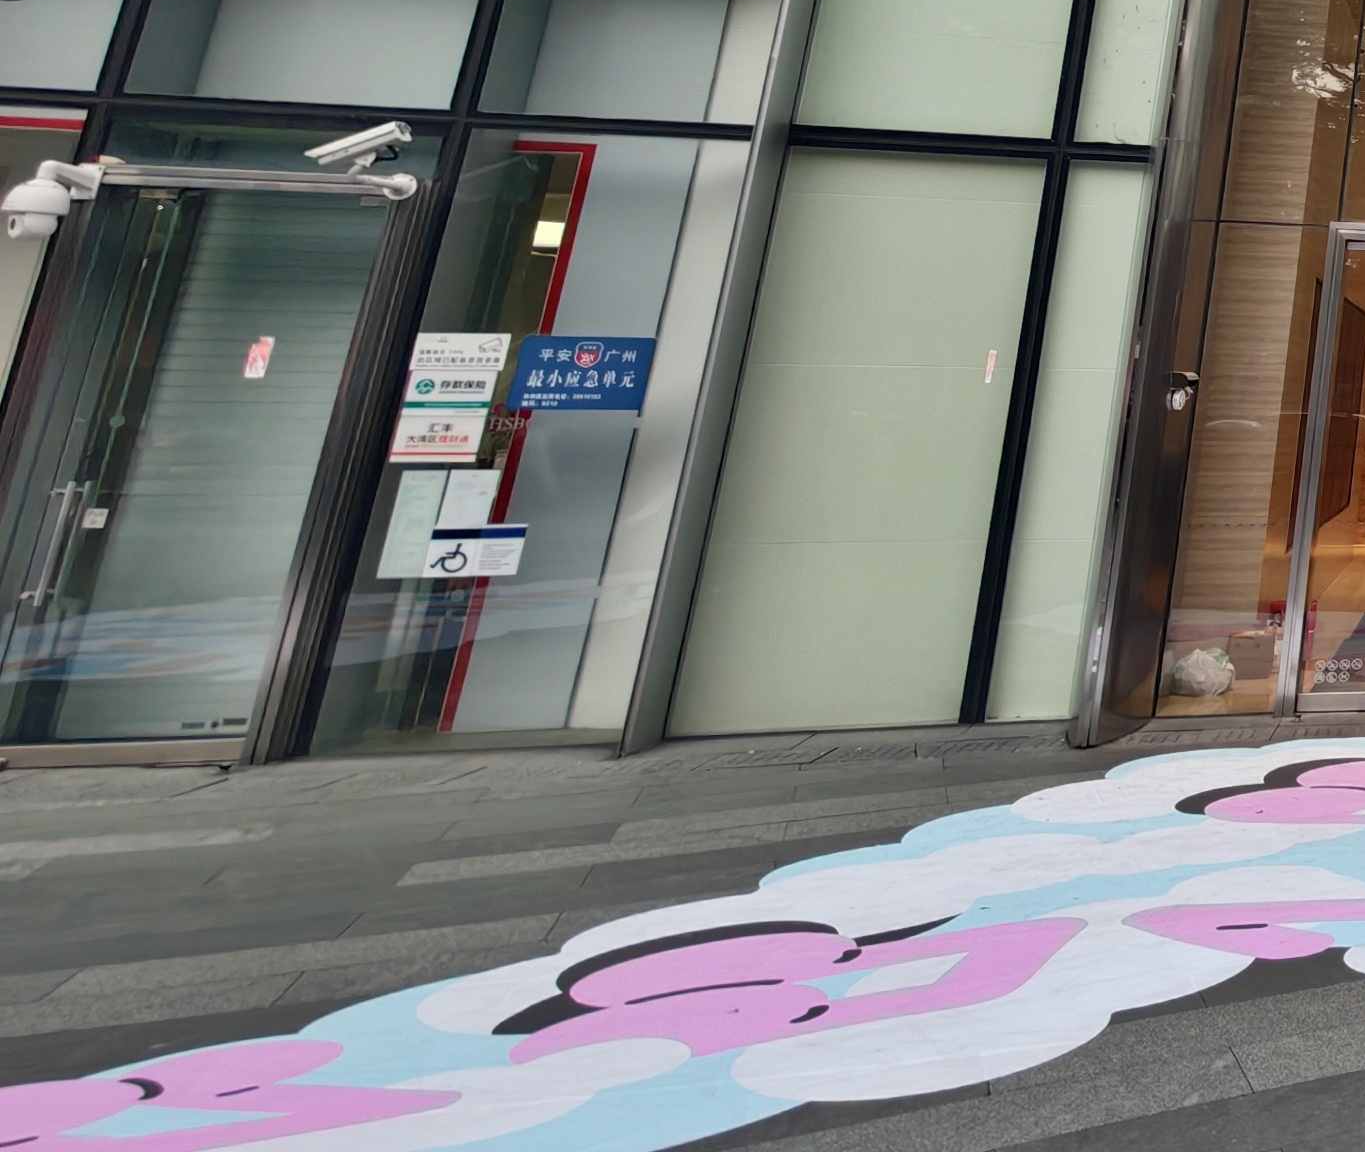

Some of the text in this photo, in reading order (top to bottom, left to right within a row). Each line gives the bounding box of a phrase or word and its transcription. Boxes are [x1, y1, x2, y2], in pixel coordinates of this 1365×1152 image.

[538, 348, 637, 363] 平安 广州
[526, 369, 636, 388] 最小应急单元
